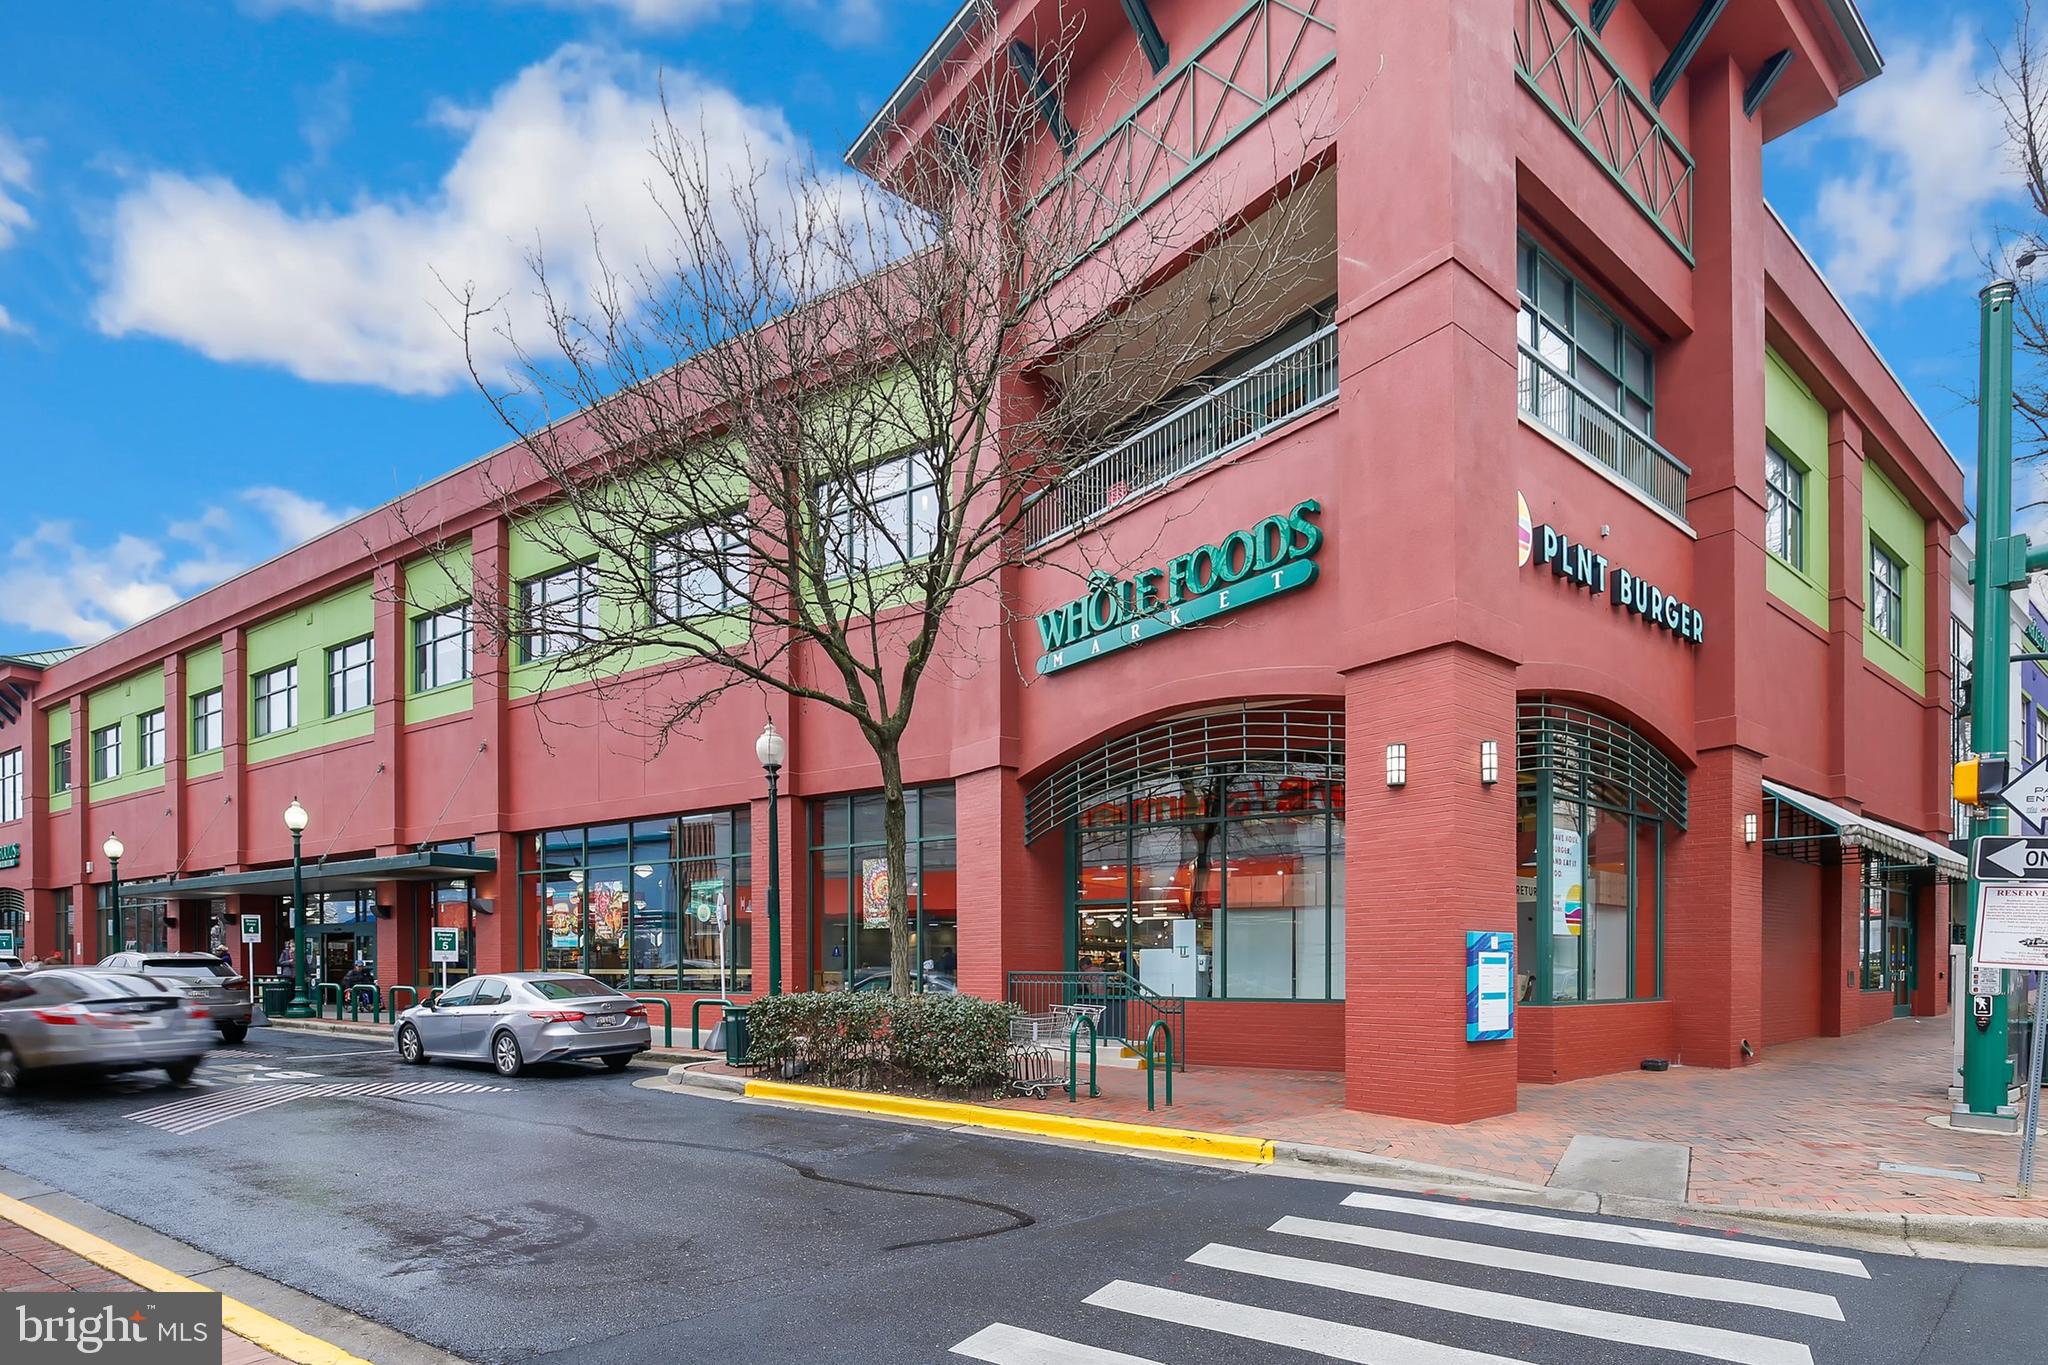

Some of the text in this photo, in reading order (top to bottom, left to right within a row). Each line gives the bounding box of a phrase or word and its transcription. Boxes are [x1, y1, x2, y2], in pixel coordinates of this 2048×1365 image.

[1036, 498, 1324, 652] WHOLE FOODS
[1053, 570, 1284, 668] MARKET
[1536, 523, 1704, 644] PLNT BURGER
[442, 941, 449, 950] 5
